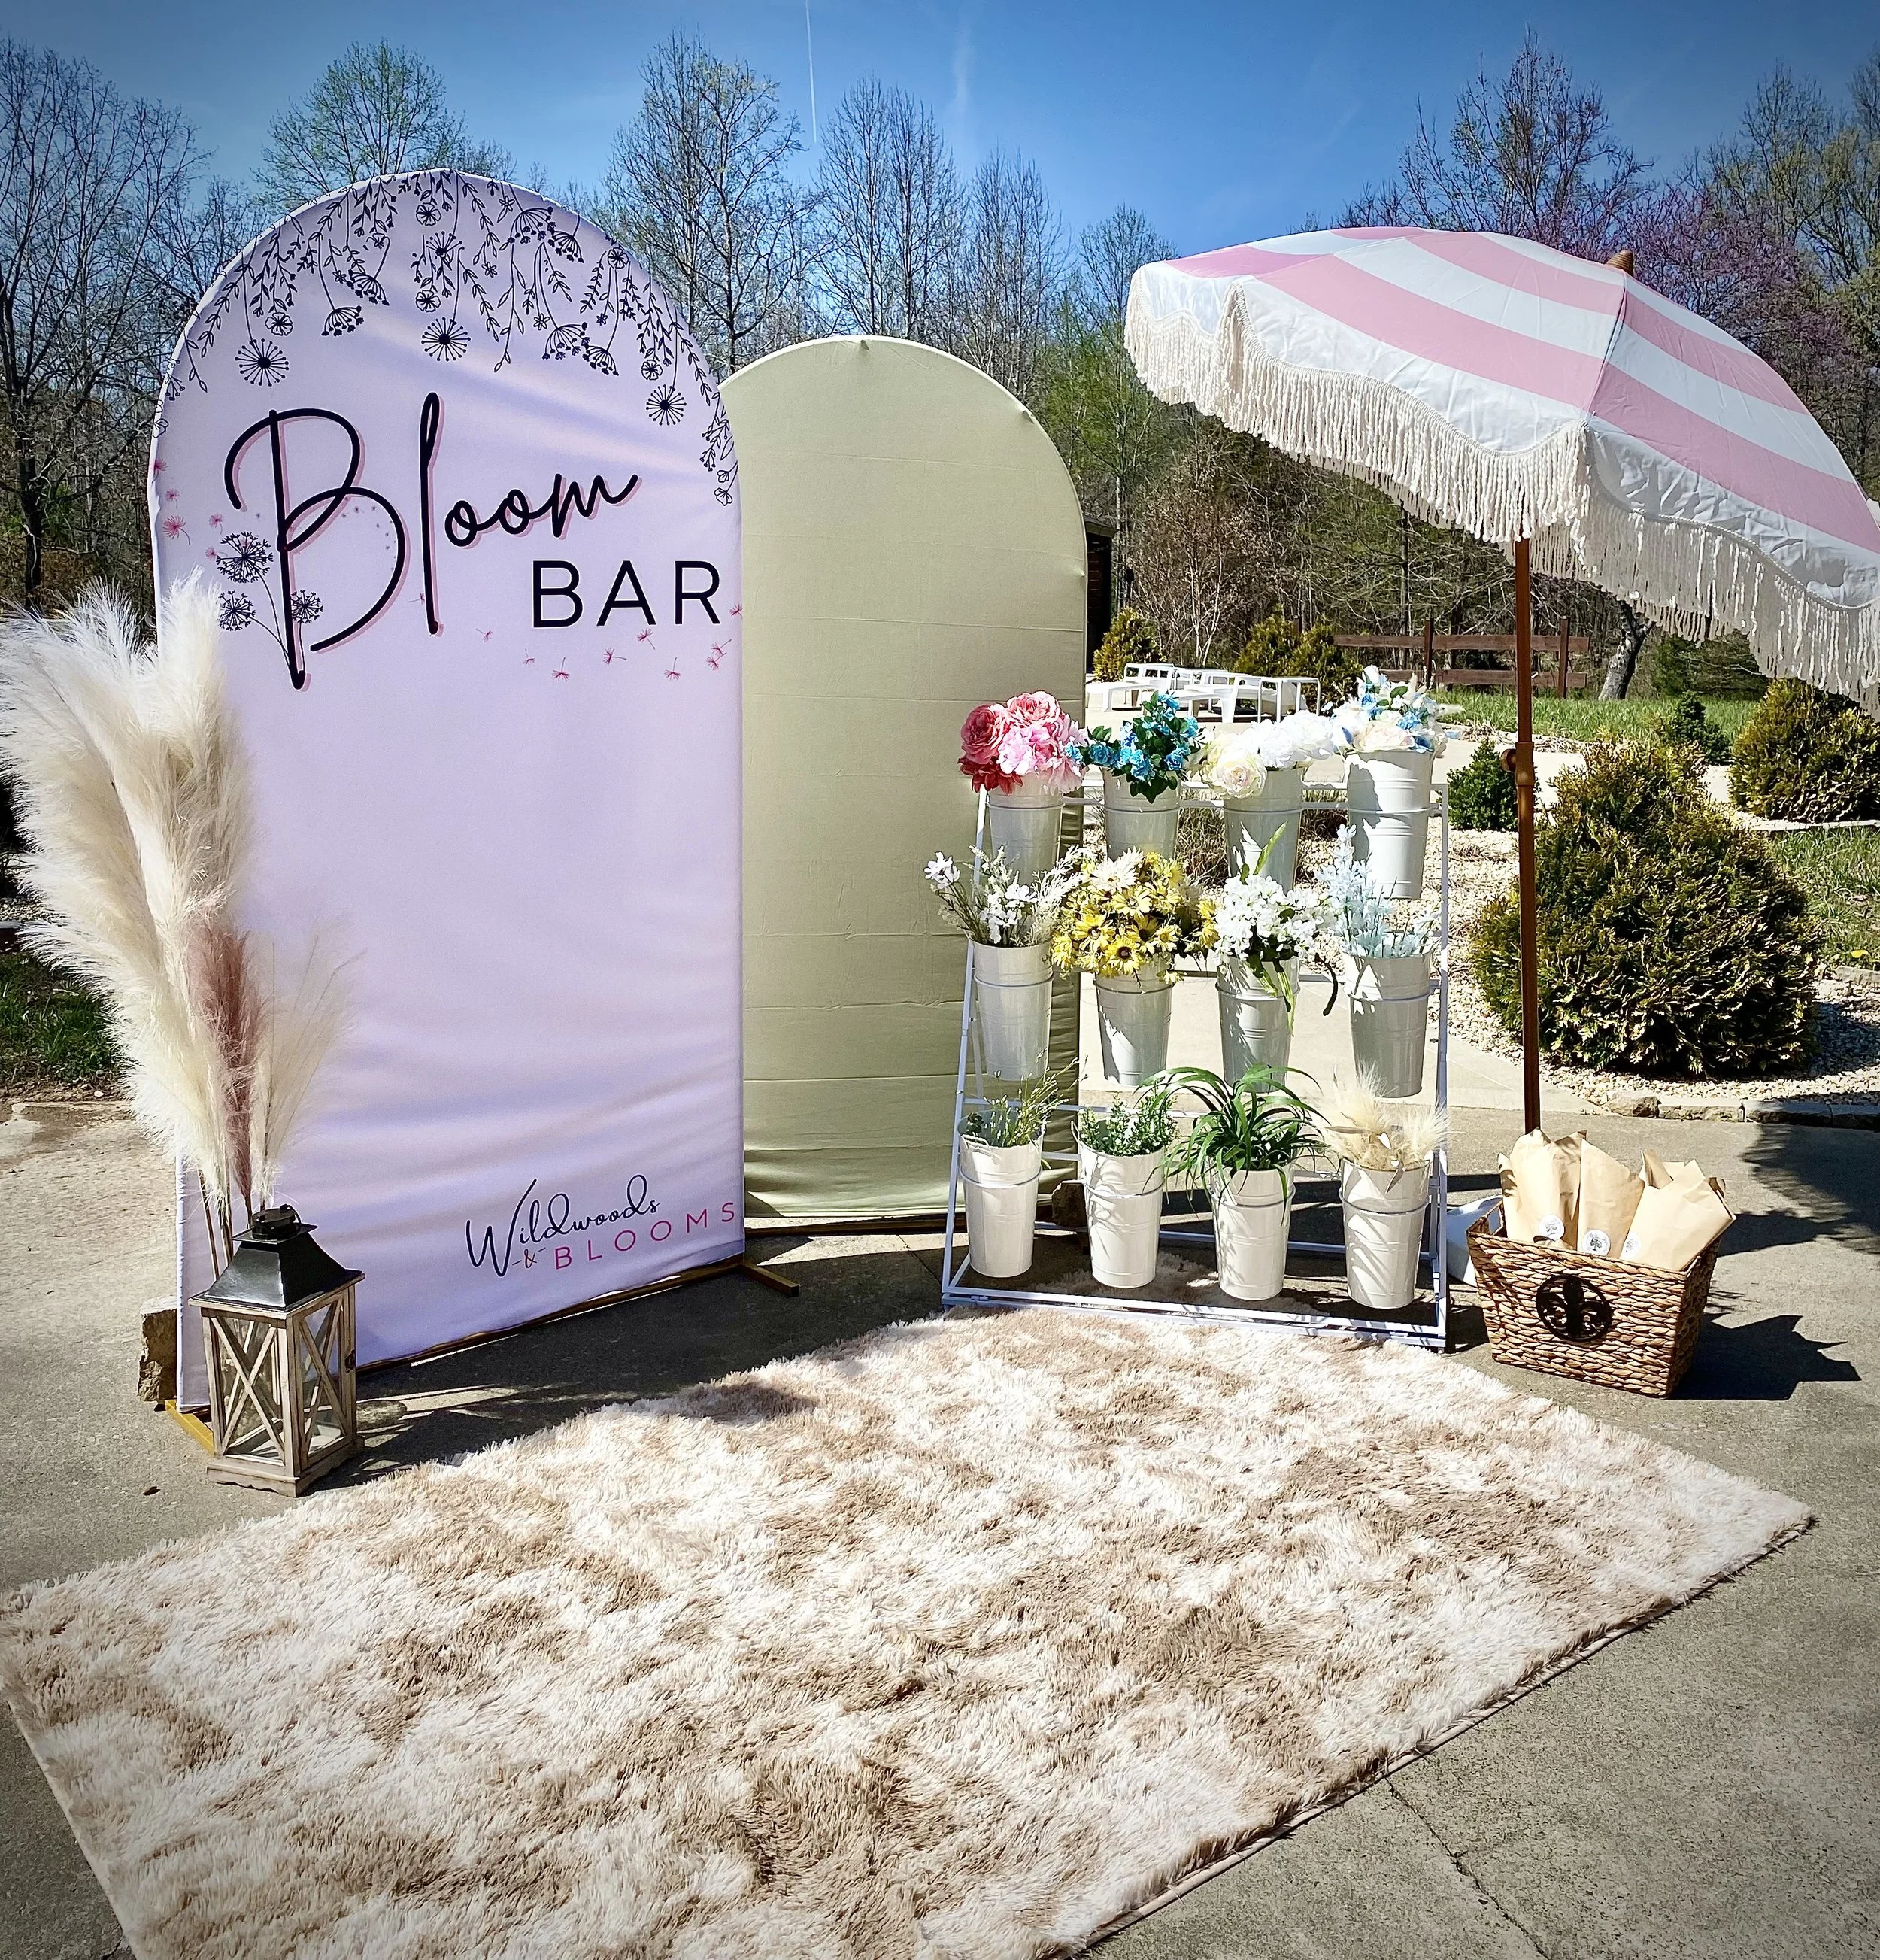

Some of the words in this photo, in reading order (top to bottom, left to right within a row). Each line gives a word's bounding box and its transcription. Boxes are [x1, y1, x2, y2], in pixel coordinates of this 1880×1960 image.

[224, 392, 641, 691] Bloom
[532, 560, 721, 628] BAR
[465, 1174, 661, 1277] Wildwoods
[554, 1203, 735, 1270] BLOOMS
